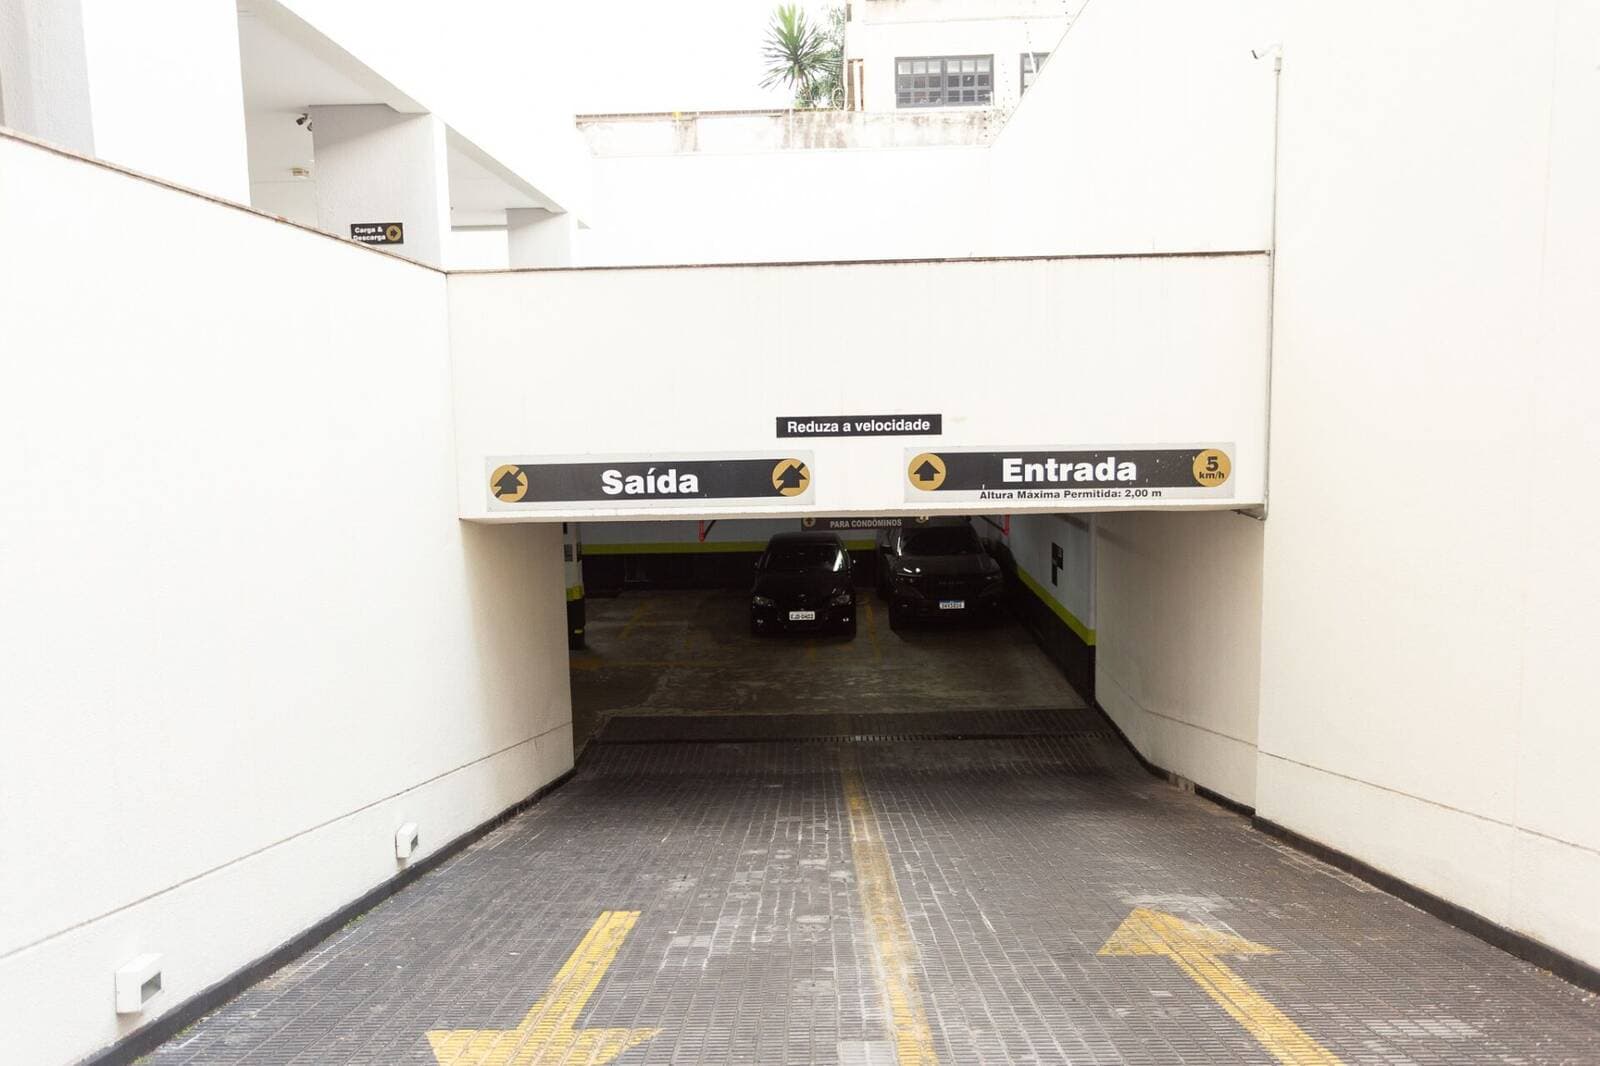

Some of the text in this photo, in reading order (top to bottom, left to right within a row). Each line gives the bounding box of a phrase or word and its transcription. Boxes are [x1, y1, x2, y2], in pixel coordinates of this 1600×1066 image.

[787, 418, 931, 433] Reduza a velocidade
[1002, 457, 1137, 482] Entrada
[1206, 456, 1219, 471] 5
[601, 467, 699, 495] Saída
[1199, 471, 1225, 479] km/h
[980, 490, 1014, 500] Altura
[1063, 488, 1121, 499] Permitida:
[1124, 488, 1148, 499] 2,00
[1151, 489, 1162, 498] m
[830, 520, 850, 528] PARA
